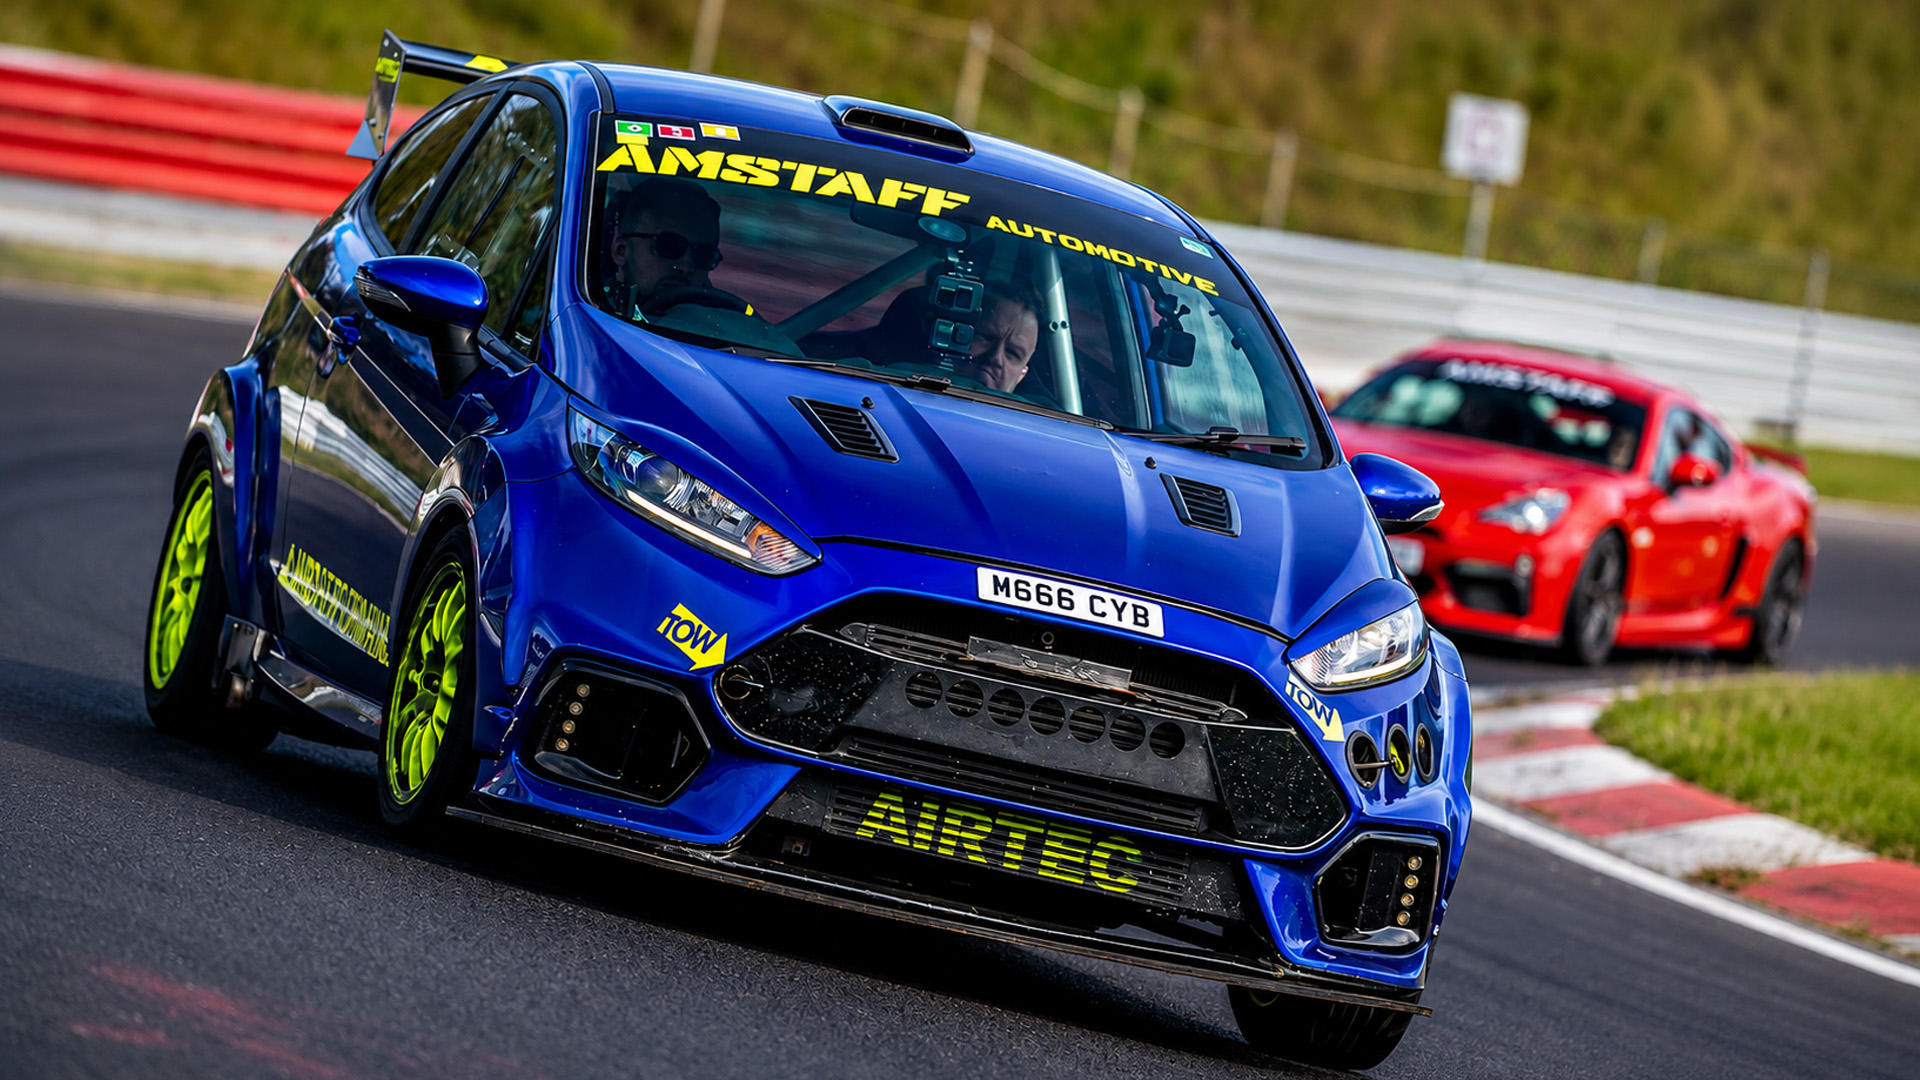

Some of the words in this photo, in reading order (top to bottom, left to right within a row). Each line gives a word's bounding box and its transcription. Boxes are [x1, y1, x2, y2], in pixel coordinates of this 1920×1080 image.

[596, 139, 971, 217] AMSTAFF
[986, 214, 1220, 297] AUTOMOTIVE
[992, 574, 1075, 611] M666
[1089, 594, 1150, 628] CYB
[661, 612, 717, 655] TOW
[1287, 680, 1334, 727] TOW
[856, 788, 1142, 893] AIRTEC
